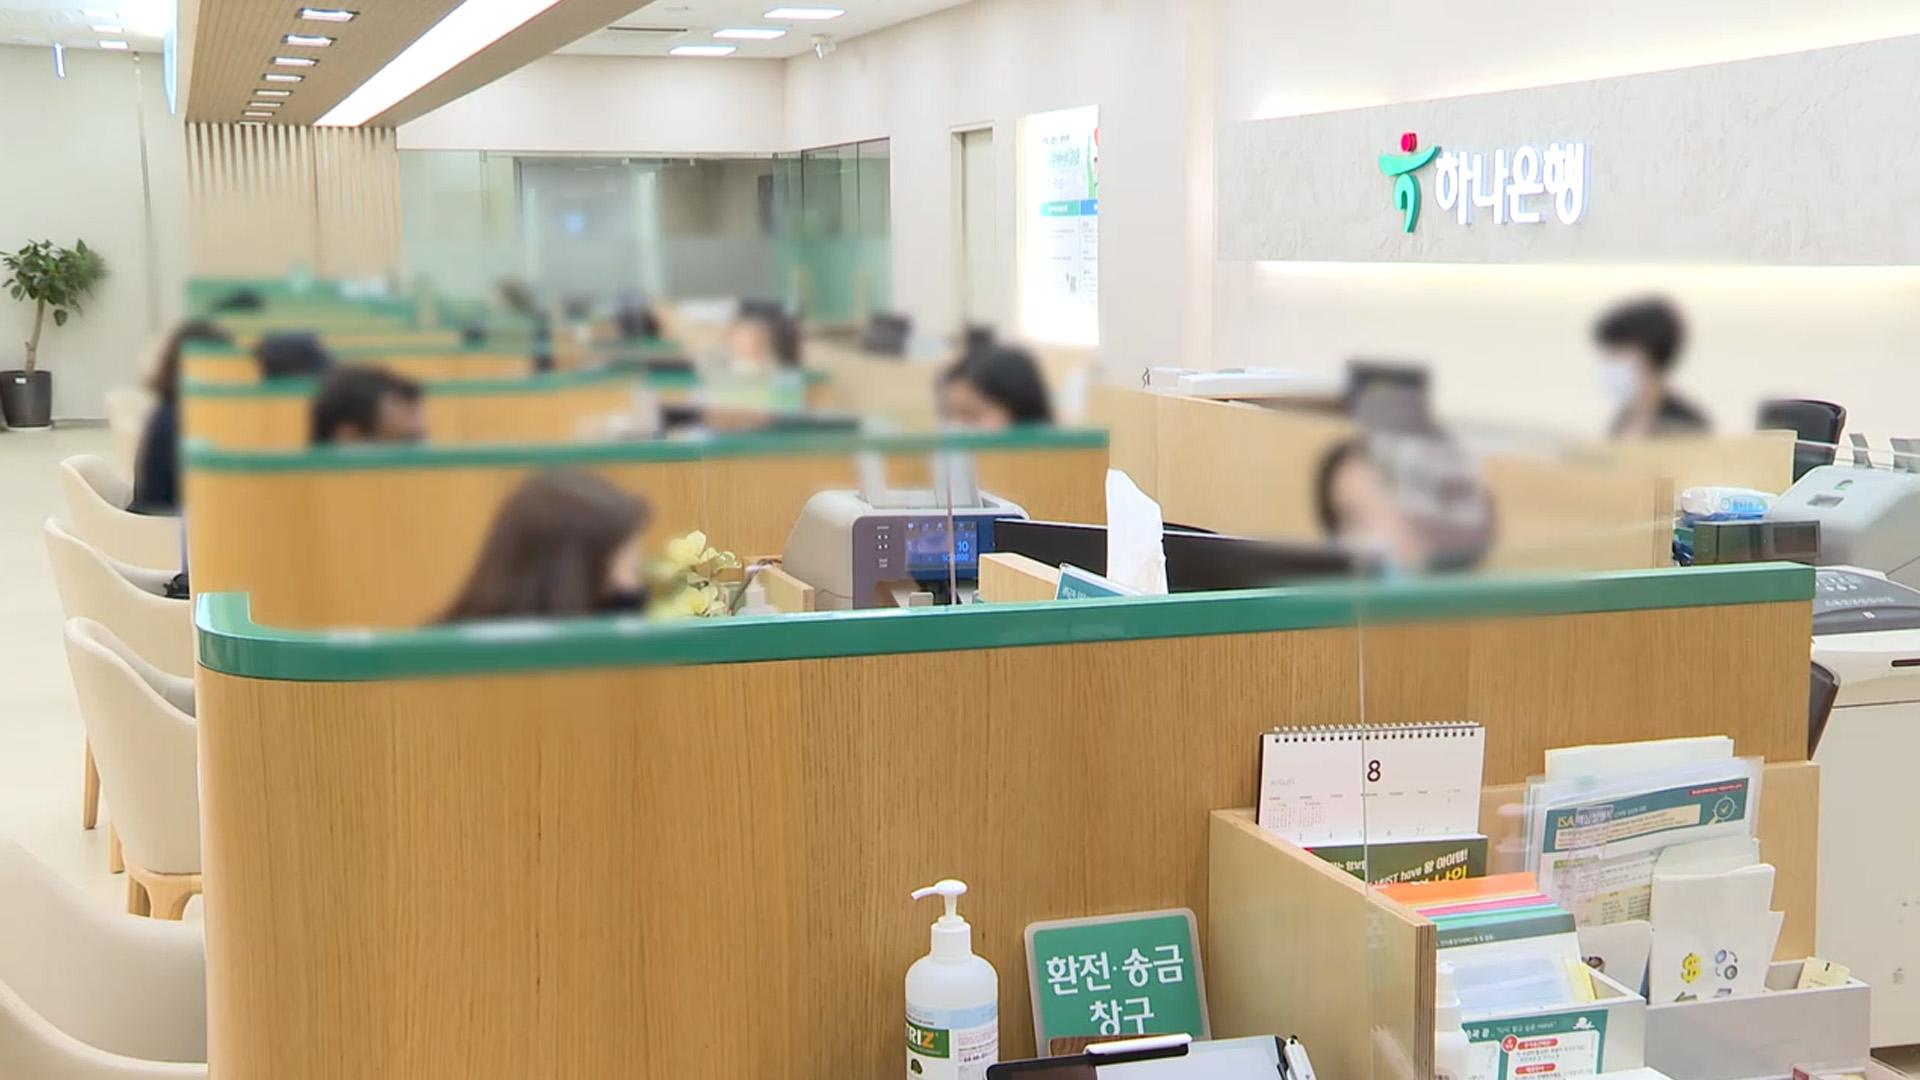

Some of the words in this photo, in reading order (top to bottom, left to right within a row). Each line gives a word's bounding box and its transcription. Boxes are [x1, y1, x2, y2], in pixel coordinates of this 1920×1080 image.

[1435, 143, 1588, 225] 하나은행
[1367, 760, 1381, 782] 8
[1401, 866, 1422, 881] have
[1088, 997, 1155, 1036] 창구
